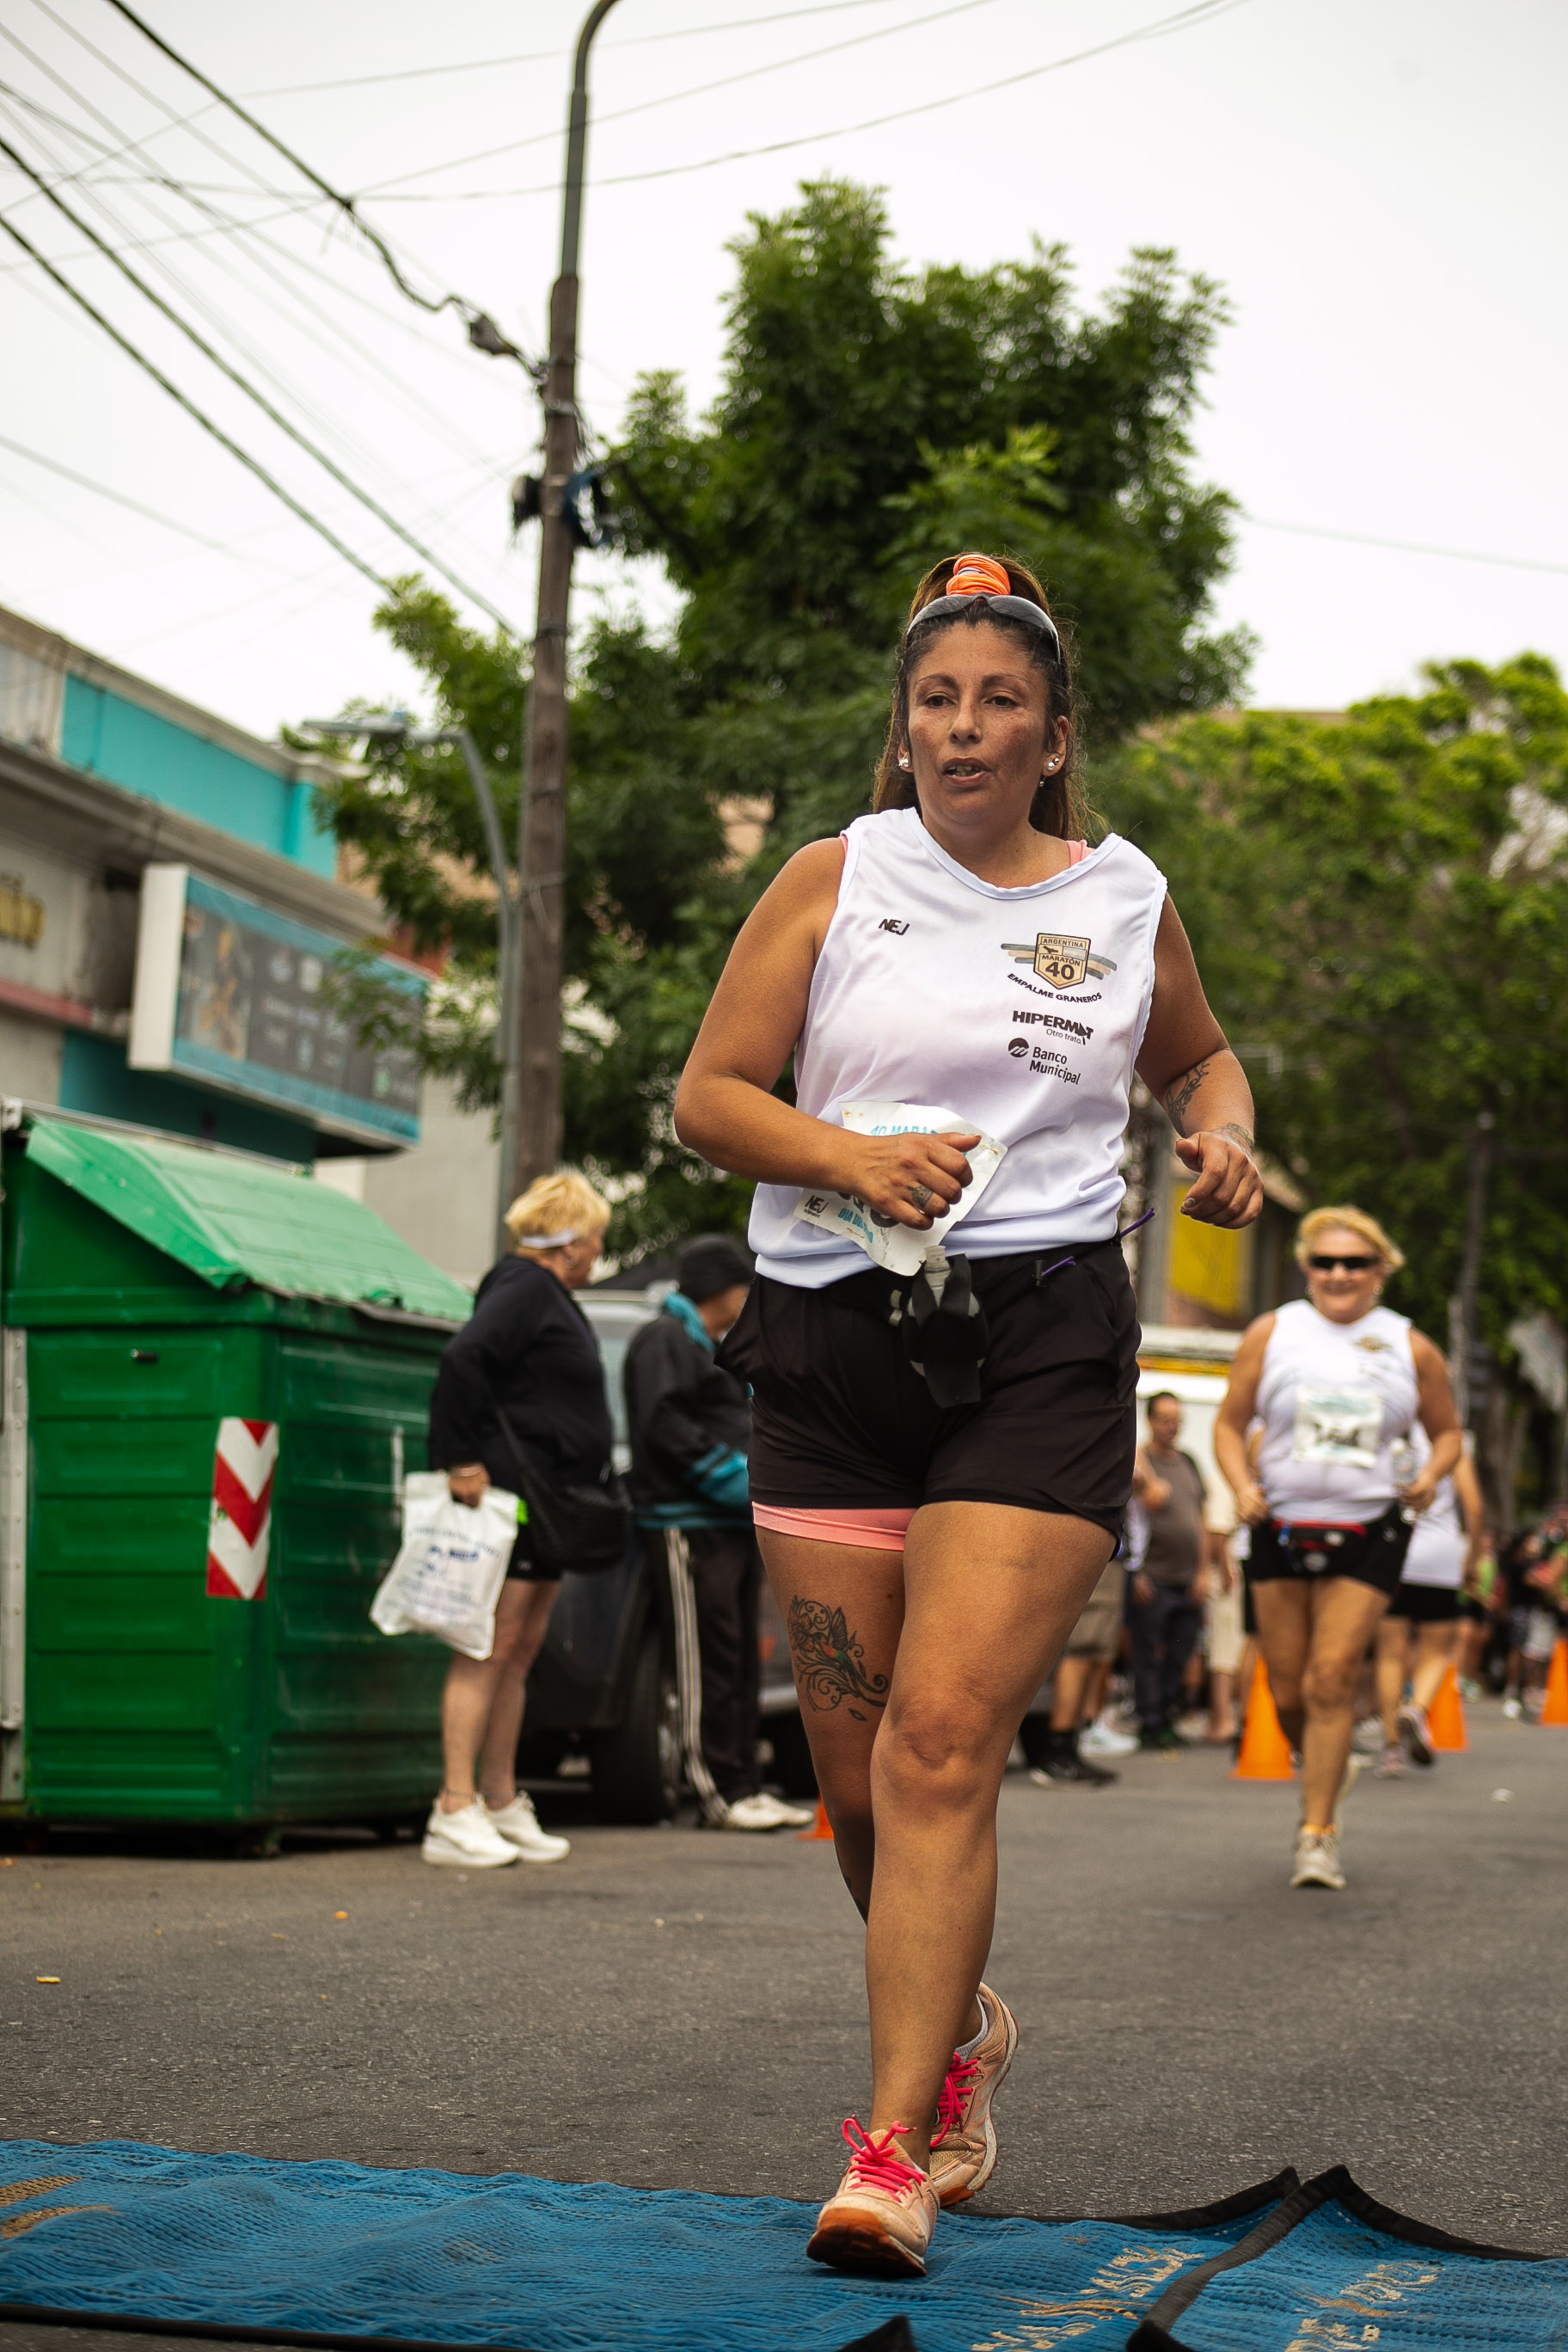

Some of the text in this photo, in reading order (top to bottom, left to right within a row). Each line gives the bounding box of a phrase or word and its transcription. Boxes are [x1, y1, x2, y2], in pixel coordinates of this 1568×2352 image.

[879, 918, 910, 935] NEJ
[1043, 938, 1083, 948] ARGENTINA
[1042, 954, 1081, 966] MARATÓN
[1045, 961, 1075, 980] 40
[1007, 973, 1102, 1003] EMPALME GRANEROS
[1046, 1028, 1063, 1038] Otro
[1032, 1046, 1068, 1065] Banco
[1029, 1060, 1081, 1085] Municipal
[805, 1195, 830, 1214] NEJ
